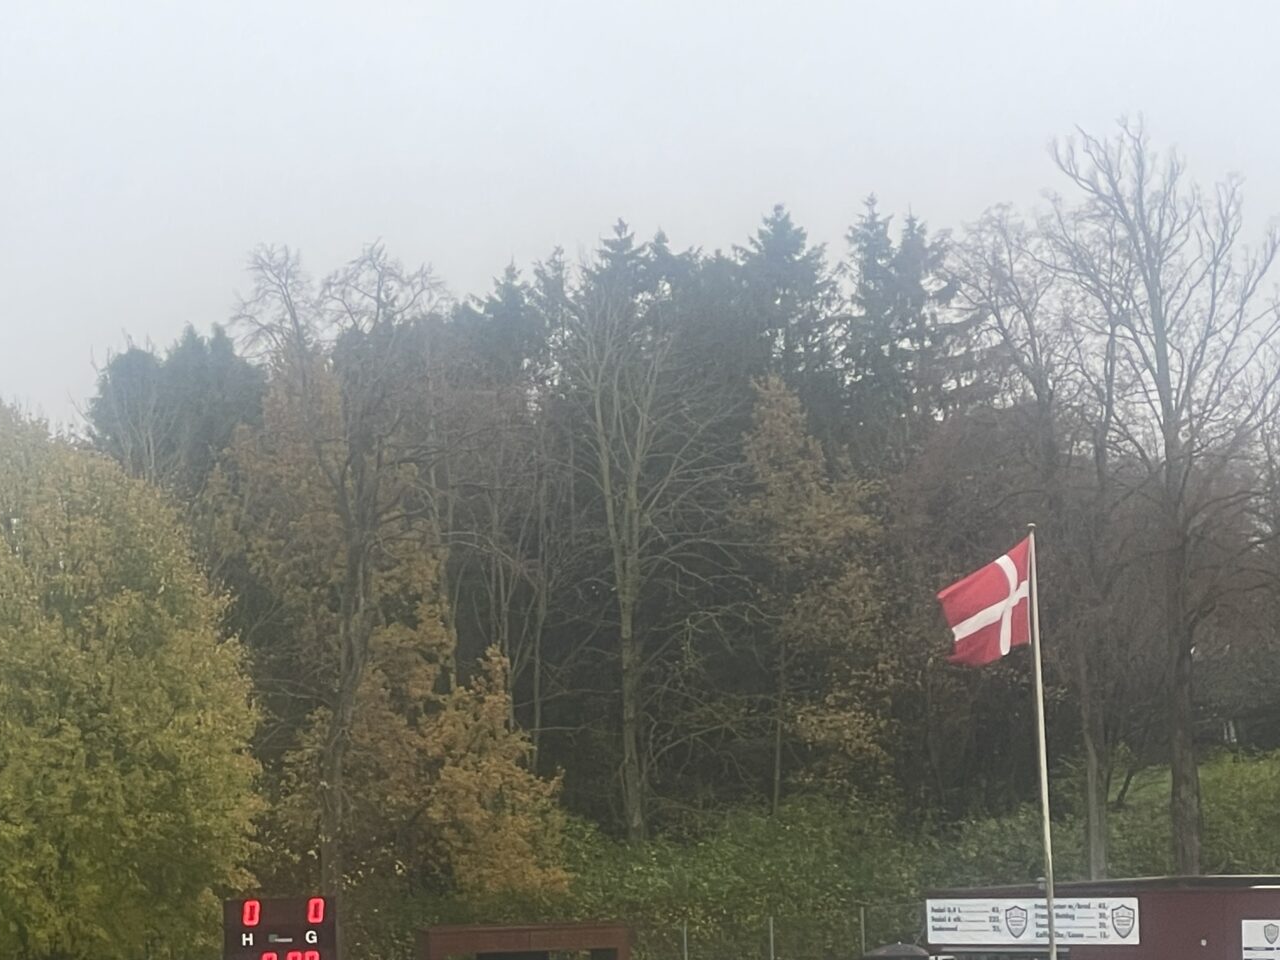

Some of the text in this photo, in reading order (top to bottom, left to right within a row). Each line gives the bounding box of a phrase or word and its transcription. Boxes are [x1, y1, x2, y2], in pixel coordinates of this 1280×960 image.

[243, 898, 325, 926] 0 0
[242, 933, 254, 946] H
[305, 930, 318, 944] G
